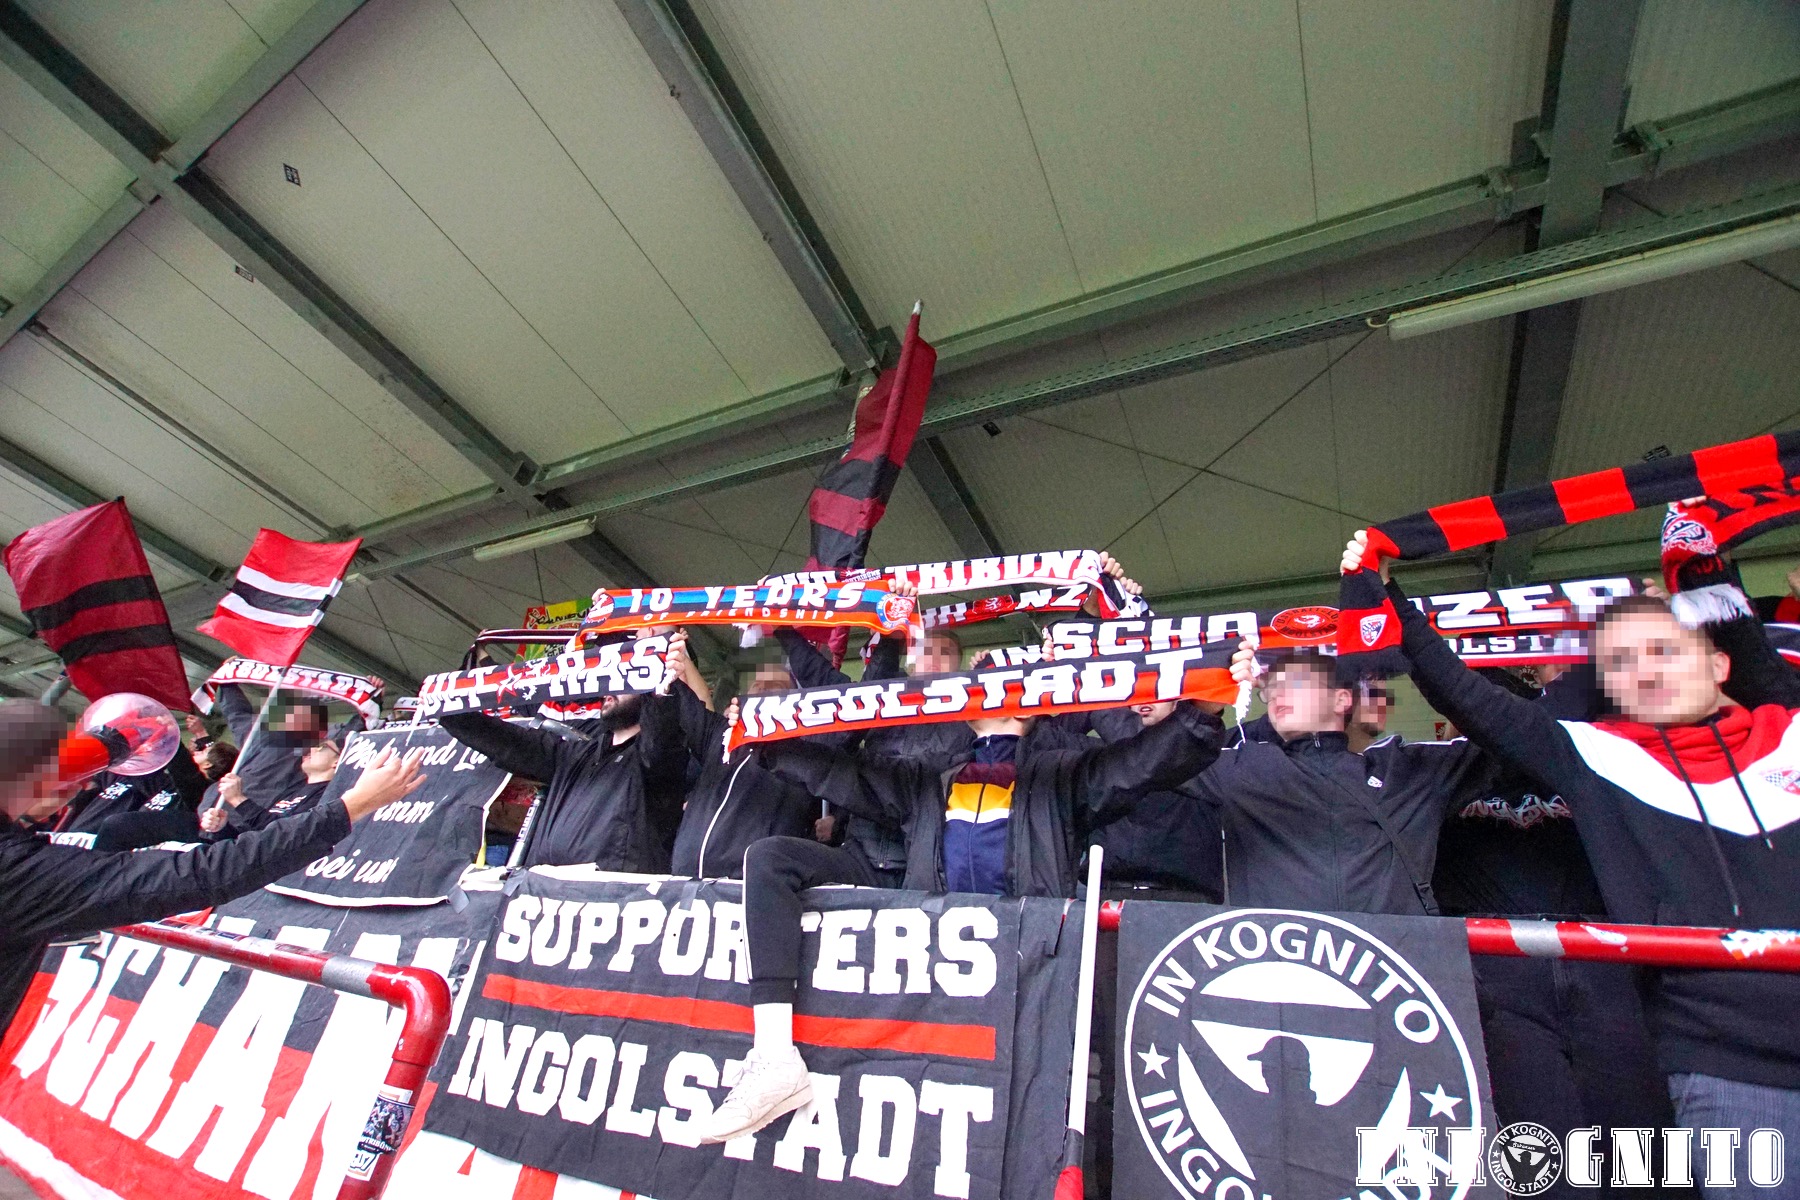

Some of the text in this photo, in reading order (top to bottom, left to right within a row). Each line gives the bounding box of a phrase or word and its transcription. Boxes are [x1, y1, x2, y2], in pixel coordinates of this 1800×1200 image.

[629, 580, 867, 613] 10 YEARS
[643, 612, 669, 621] OF
[213, 660, 374, 706] NGOLSTADT
[742, 648, 1203, 738] INGOLSTADT
[496, 894, 998, 998] SUPPORERS
[1144, 921, 1440, 1044] IN KOGNITO
